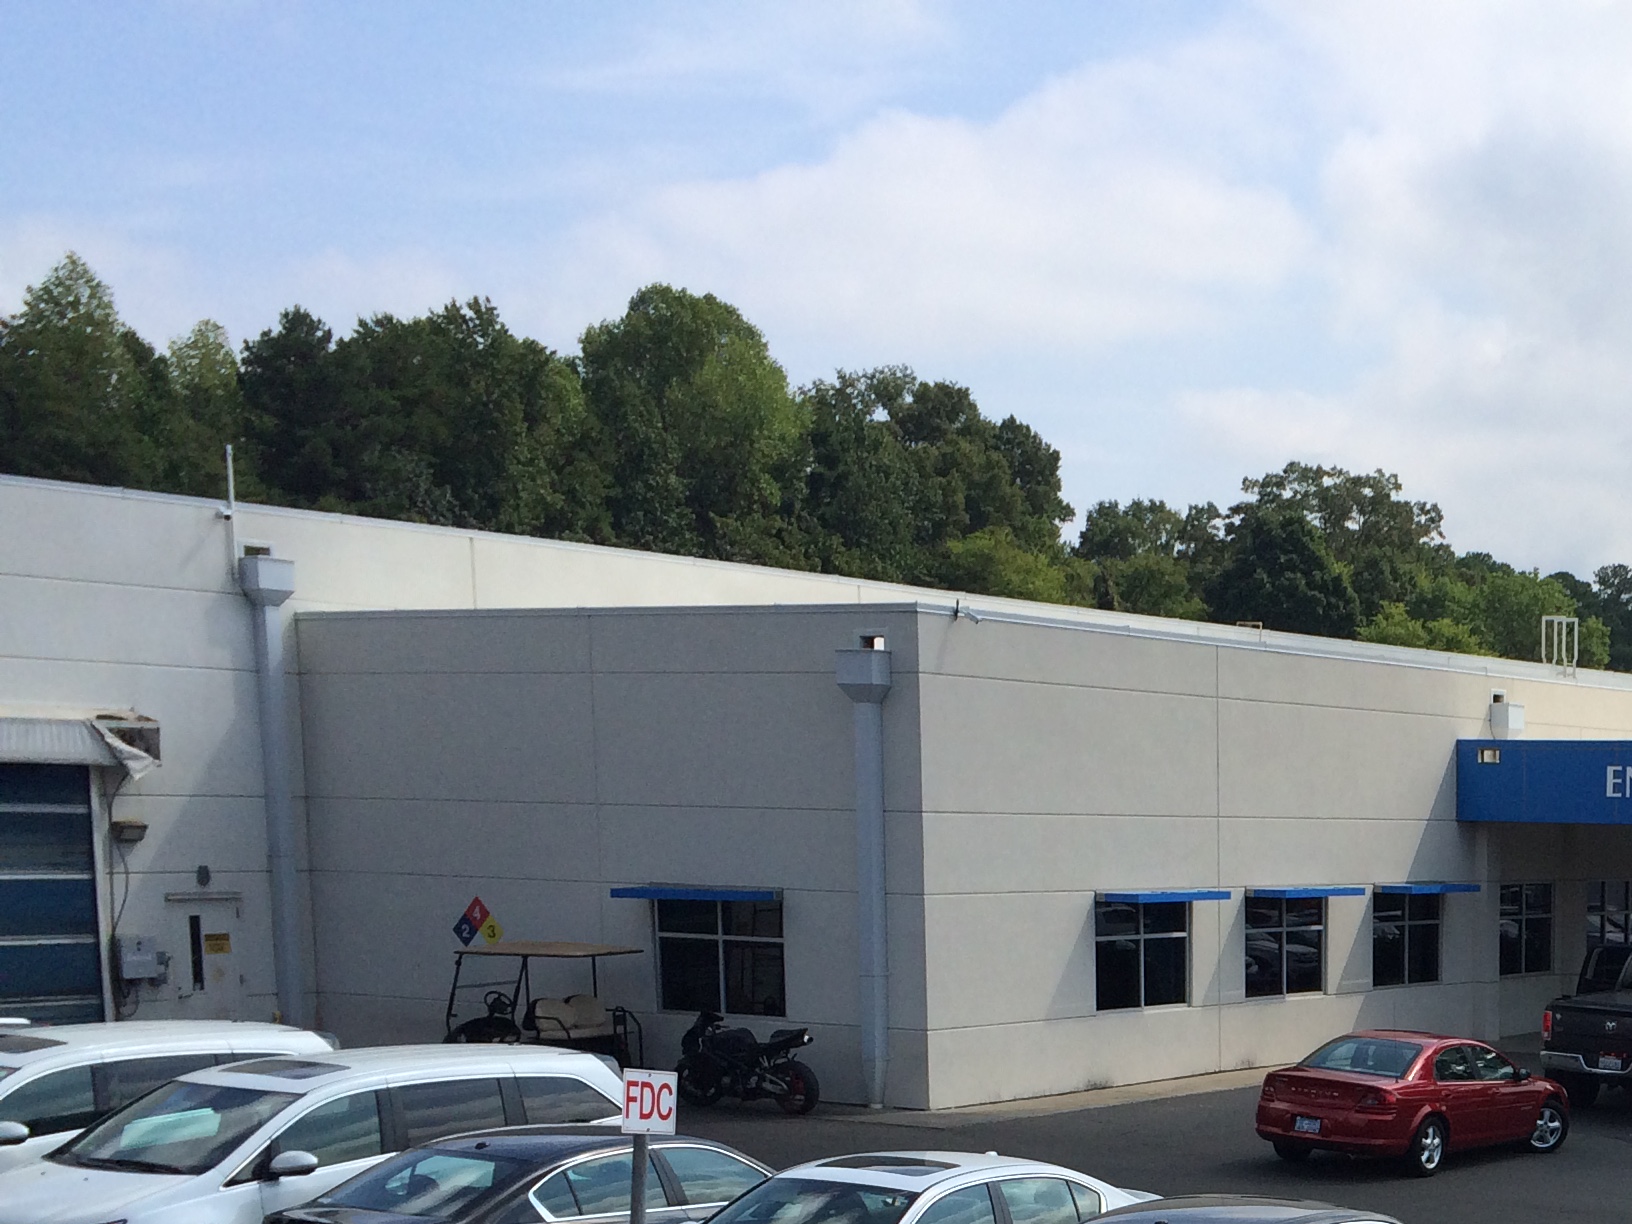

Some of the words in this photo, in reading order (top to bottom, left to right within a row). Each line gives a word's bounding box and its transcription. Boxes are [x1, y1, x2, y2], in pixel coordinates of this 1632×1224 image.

[472, 905, 481, 921] 4
[461, 923, 471, 938] 2
[486, 924, 497, 939] 3
[625, 1079, 673, 1121] FDC
